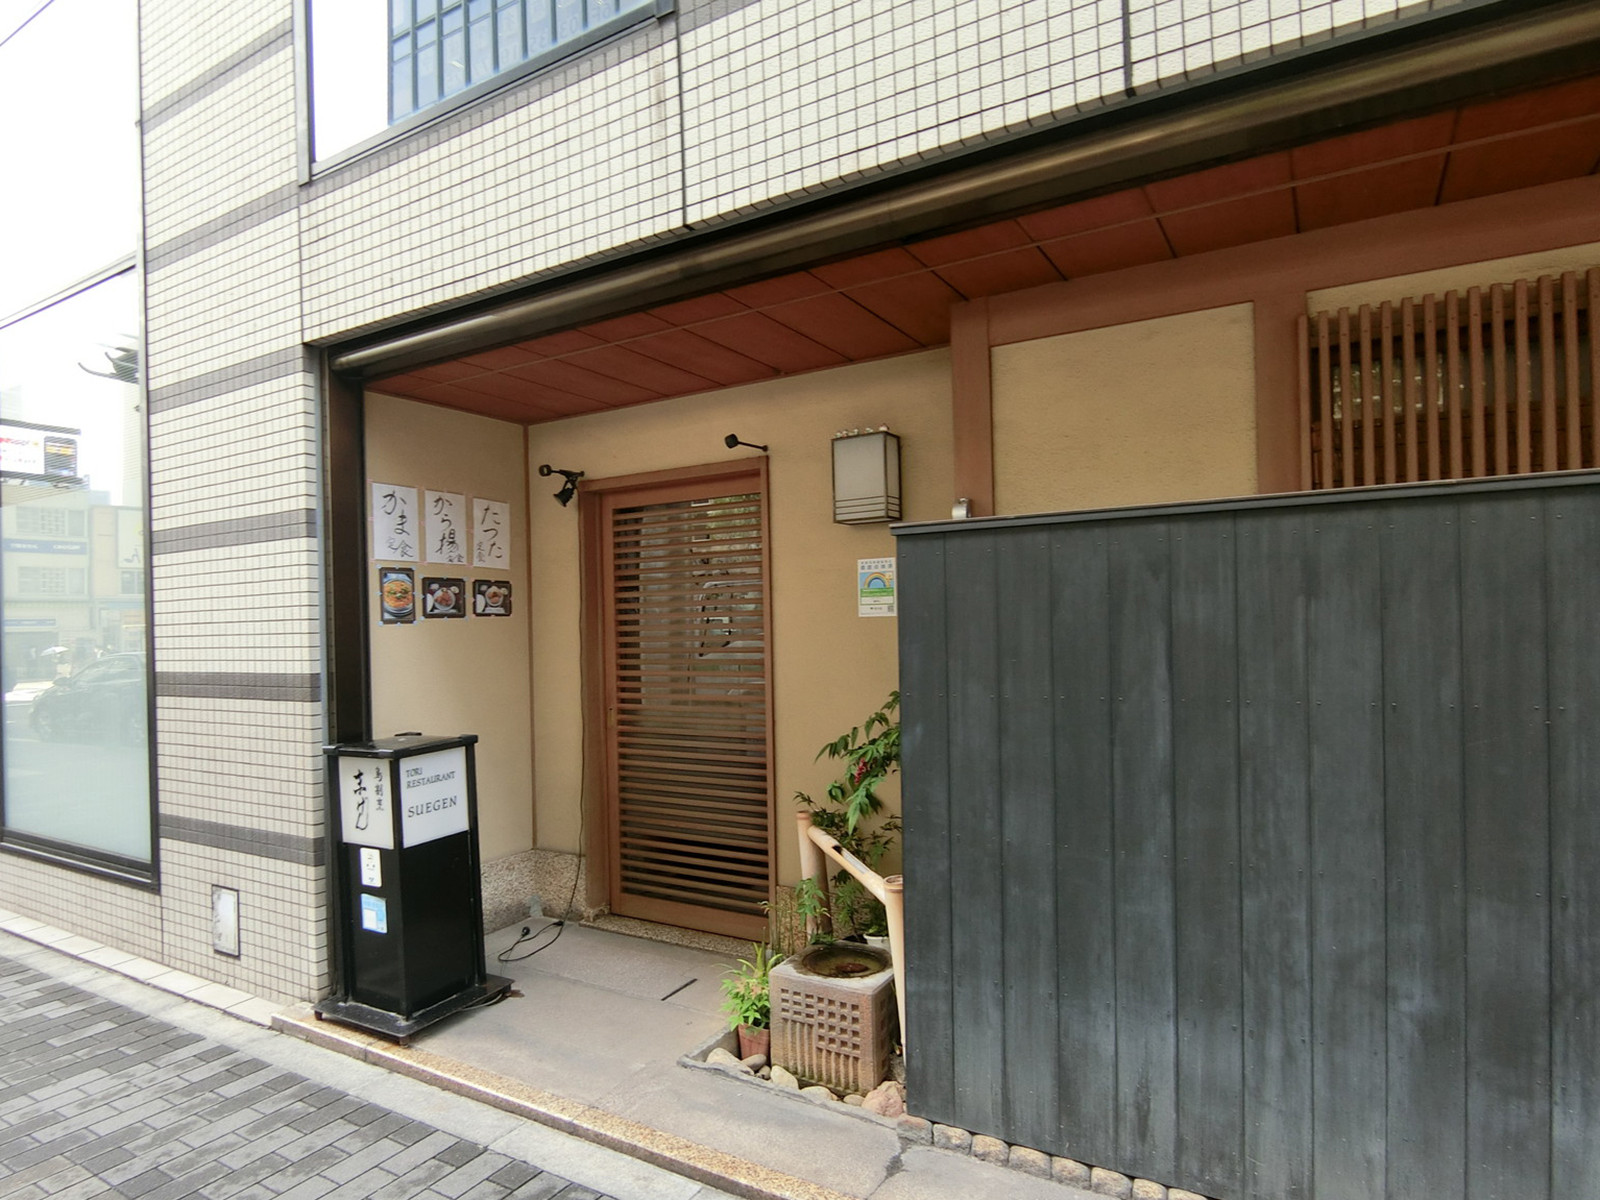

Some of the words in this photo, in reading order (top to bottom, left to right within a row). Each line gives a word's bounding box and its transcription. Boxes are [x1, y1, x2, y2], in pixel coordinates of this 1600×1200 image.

[406, 768, 423, 778] TORI
[406, 771, 456, 789] RESTAURANT
[408, 796, 457, 818] SUEGEN
